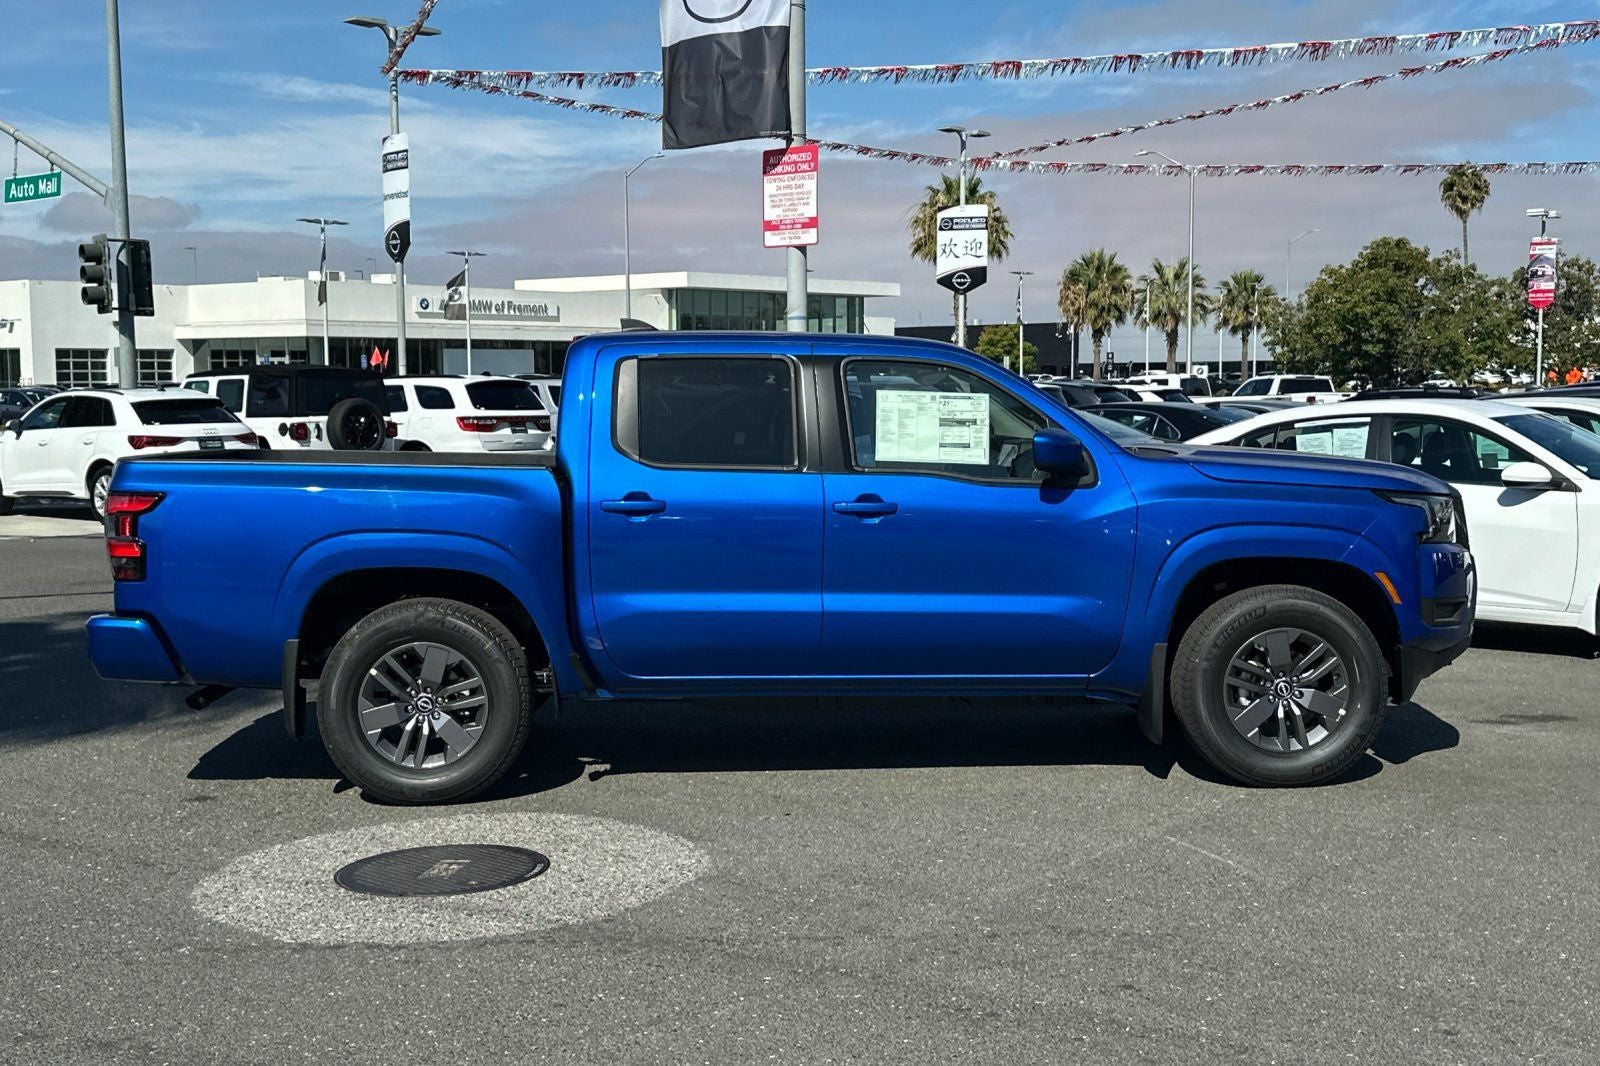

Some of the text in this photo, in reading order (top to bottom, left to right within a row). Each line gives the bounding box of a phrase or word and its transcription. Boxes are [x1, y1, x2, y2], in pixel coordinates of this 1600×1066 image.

[769, 152, 813, 165] AUTHORIZED
[766, 161, 815, 174] PARKING ONLY
[766, 174, 815, 184] TOWING ENFORCED
[9, 177, 58, 199] Auto Mall
[939, 237, 984, 259] 欢迎
[494, 300, 505, 314] of
[507, 301, 549, 316] Fremont
